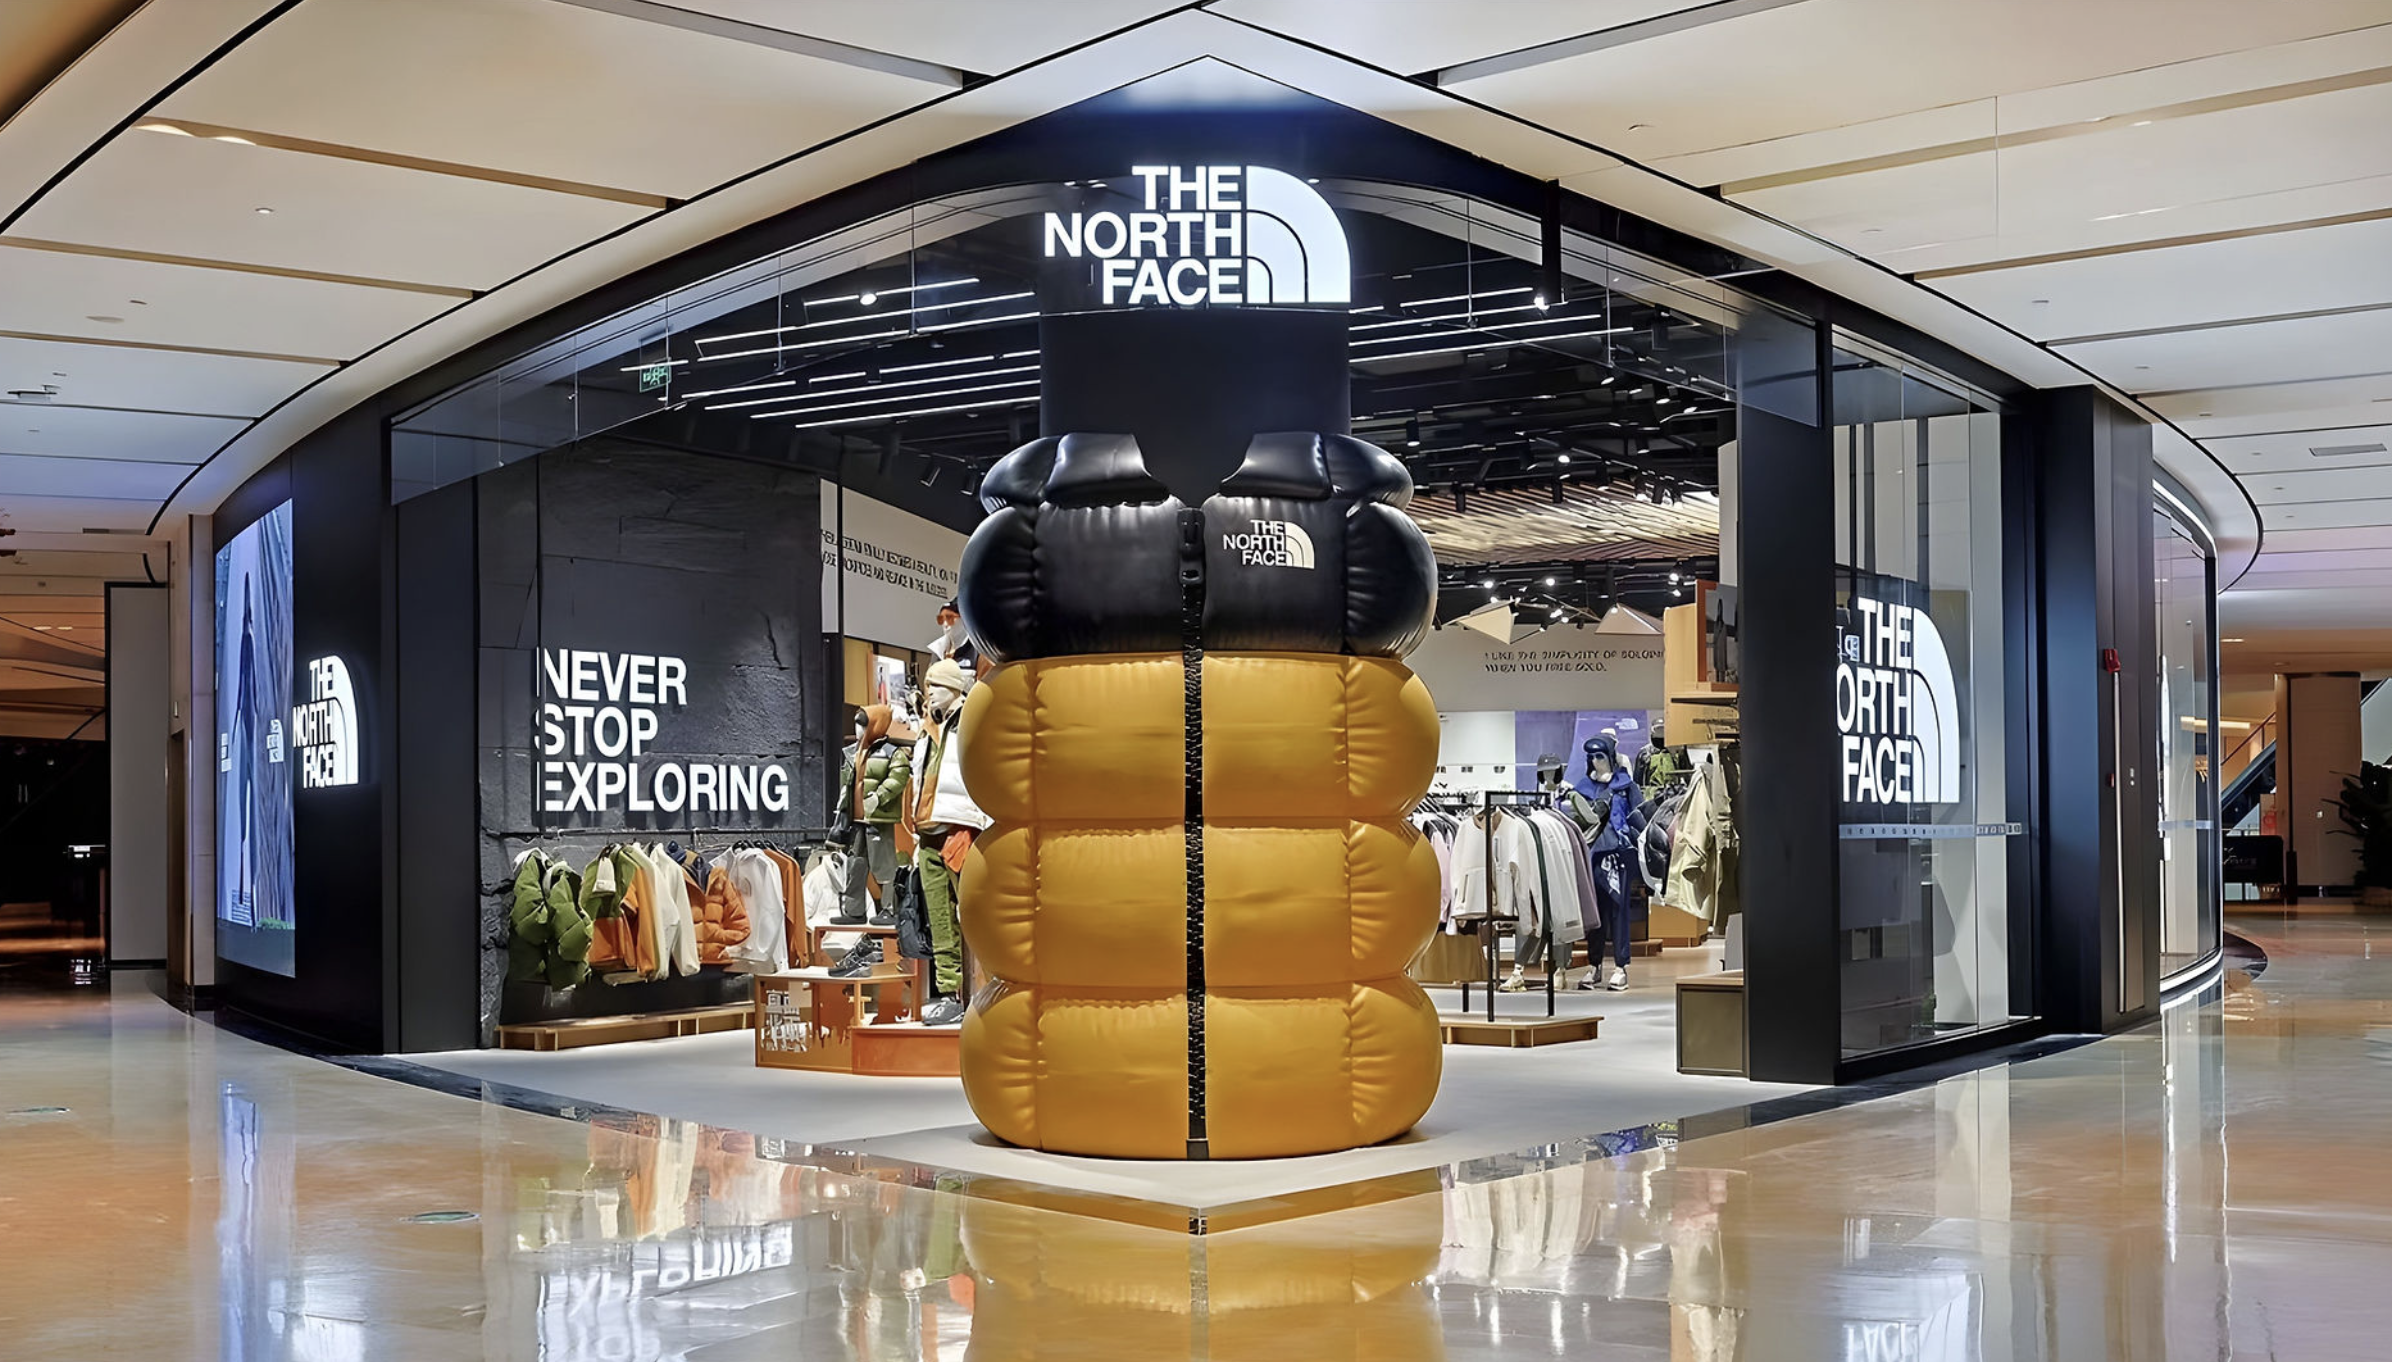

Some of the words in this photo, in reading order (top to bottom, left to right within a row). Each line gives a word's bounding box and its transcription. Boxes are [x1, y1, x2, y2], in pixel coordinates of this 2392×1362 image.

[1132, 166, 1241, 210] THE
[1044, 211, 1242, 258] NORTH
[1103, 258, 1243, 305] FACE
[1223, 534, 1285, 551] NORTH
[1250, 519, 1284, 535] THE
[1242, 550, 1287, 567] FACE
[1858, 597, 1912, 670] THE
[309, 657, 333, 702] THE
[537, 646, 687, 706] NEVER
[1836, 663, 1912, 736] ORTH
[293, 700, 332, 747] NORTH
[534, 703, 658, 757] STOP
[303, 743, 333, 788] FACE
[537, 761, 789, 812] EXPLORING
[1842, 734, 1912, 805] FACE
